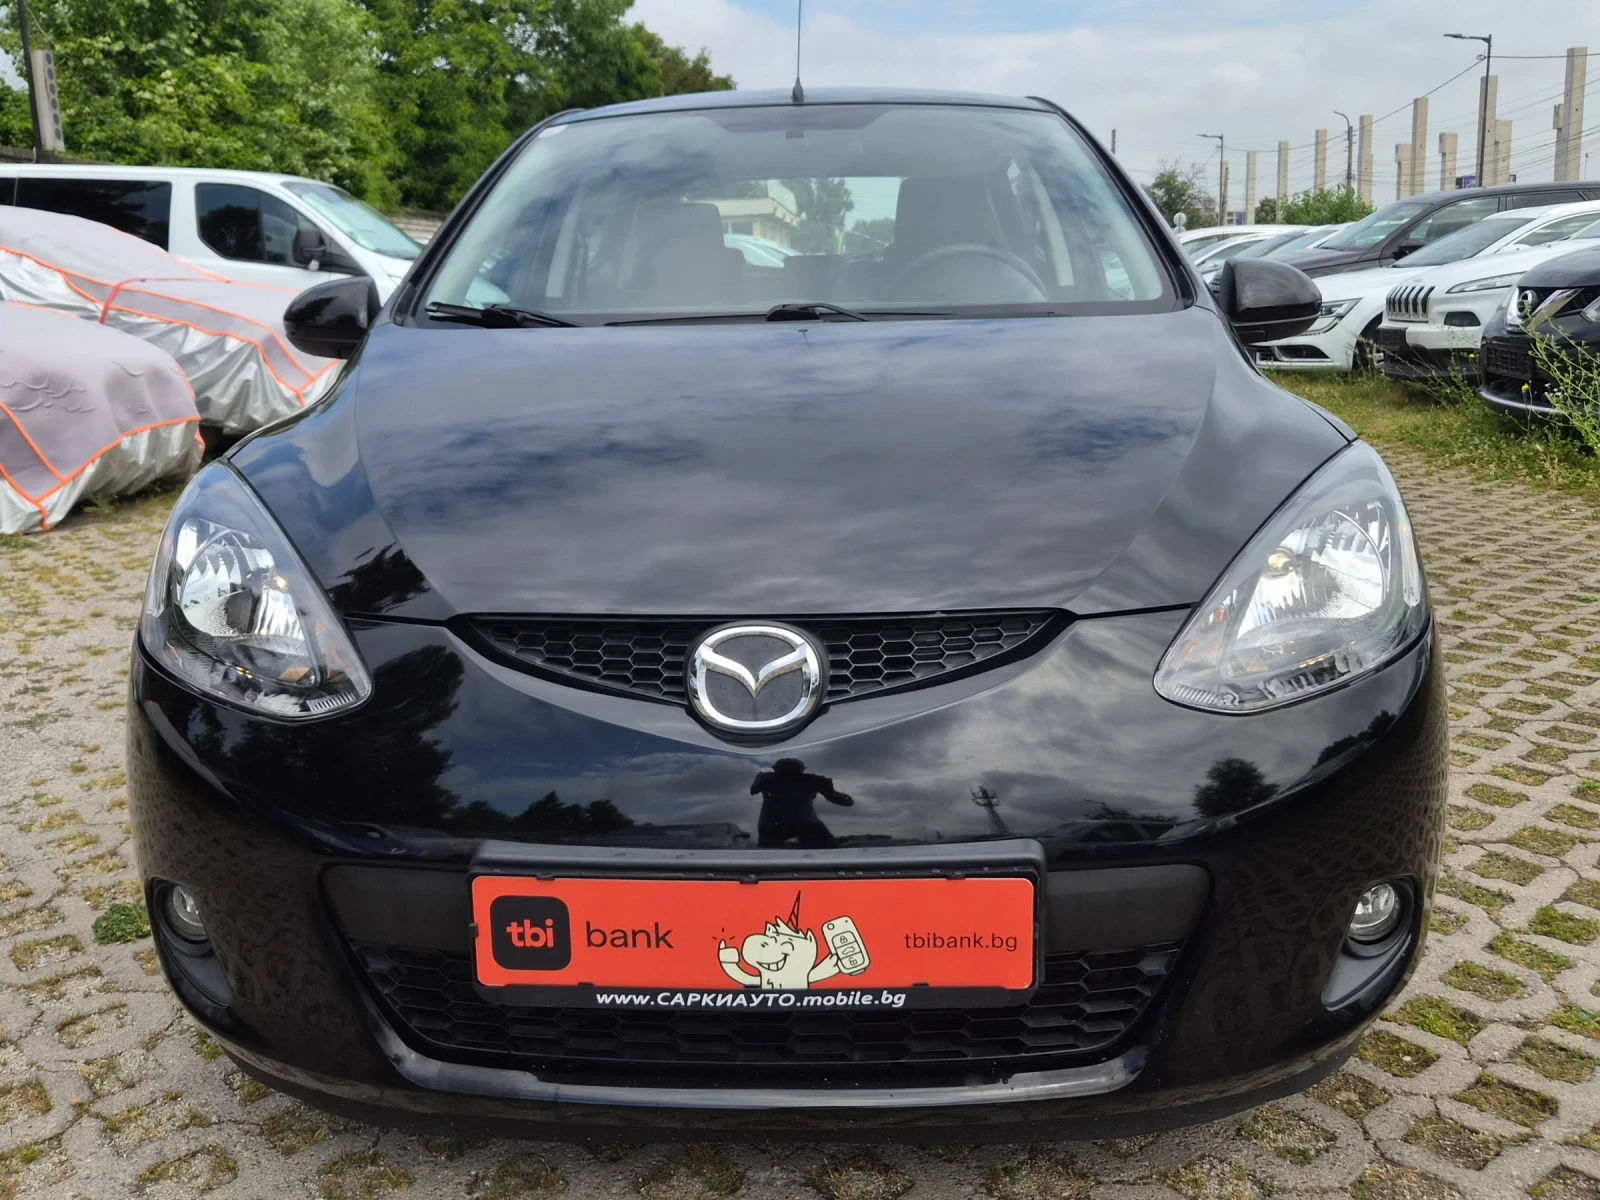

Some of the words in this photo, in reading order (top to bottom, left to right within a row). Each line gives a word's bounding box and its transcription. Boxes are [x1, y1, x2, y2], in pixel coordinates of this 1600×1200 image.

[506, 918, 555, 948] tbi
[586, 921, 675, 949] bank
[904, 932, 1018, 953] tbibank.bg
